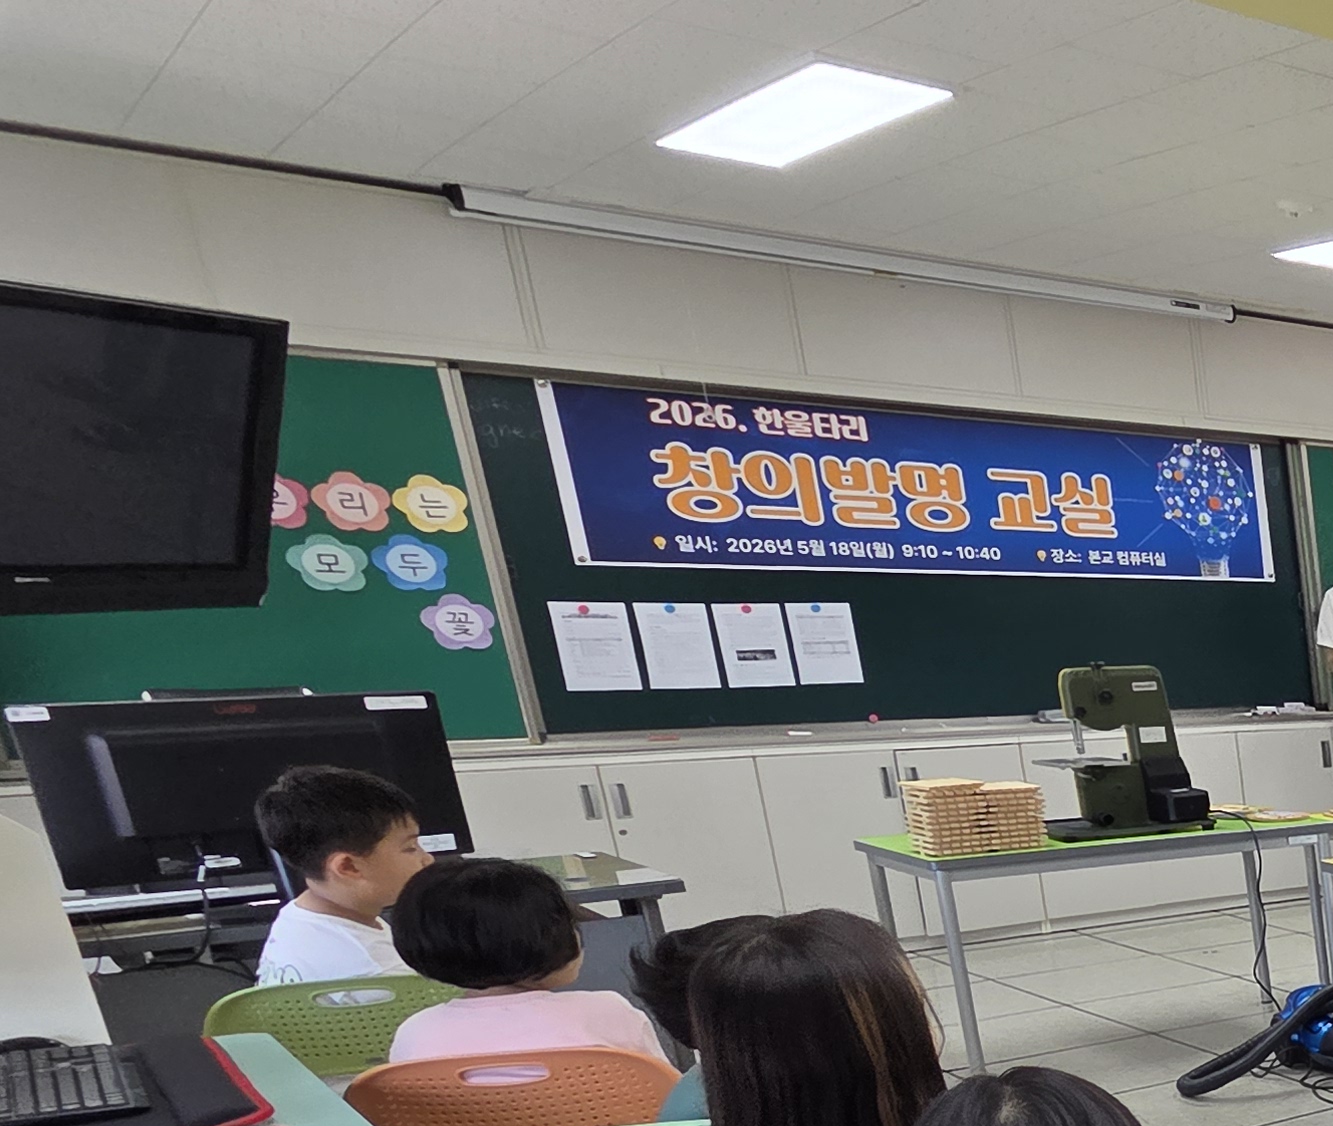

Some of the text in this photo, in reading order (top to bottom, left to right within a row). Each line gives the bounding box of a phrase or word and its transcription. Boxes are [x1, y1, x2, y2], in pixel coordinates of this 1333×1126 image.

[646, 398, 869, 442] 2026. 한울타리
[650, 441, 1118, 538] 창의발명 교실
[674, 535, 718, 553] 일시:
[725, 537, 794, 556] 2026년
[797, 539, 826, 557] 5월
[829, 541, 895, 559] 18일(월)
[901, 545, 938, 559] 9:10
[956, 546, 1001, 561] 10:40
[1050, 548, 1167, 567] 장소: 본교 컴퓨터실
[444, 611, 475, 637] 꽃
